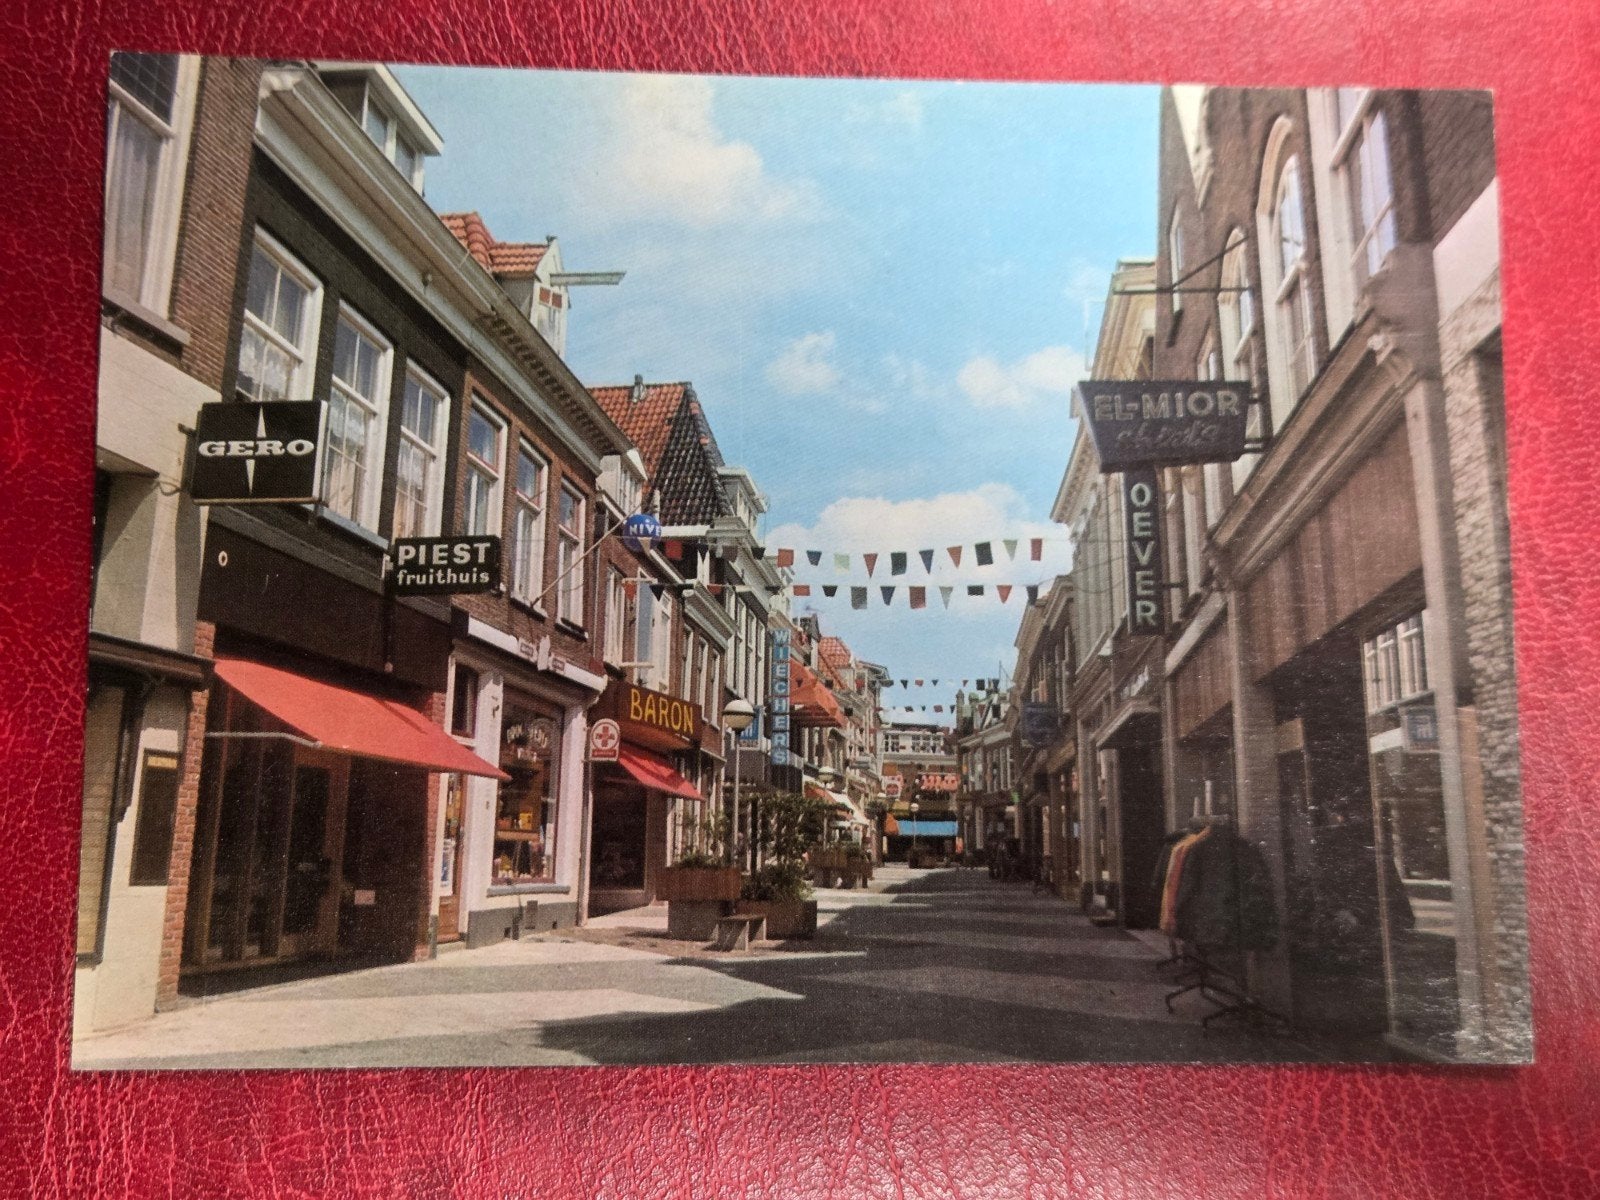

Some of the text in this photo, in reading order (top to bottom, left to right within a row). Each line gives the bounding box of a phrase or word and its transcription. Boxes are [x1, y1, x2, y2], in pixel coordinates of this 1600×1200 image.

[1094, 391, 1240, 421] EL-MIOR
[198, 439, 315, 457] GERO
[398, 542, 491, 566] PIEST
[1130, 482, 1156, 626] OEVER
[397, 567, 490, 586] fruithuis
[630, 688, 694, 734] BARON
[772, 631, 790, 763] WIECHERS
